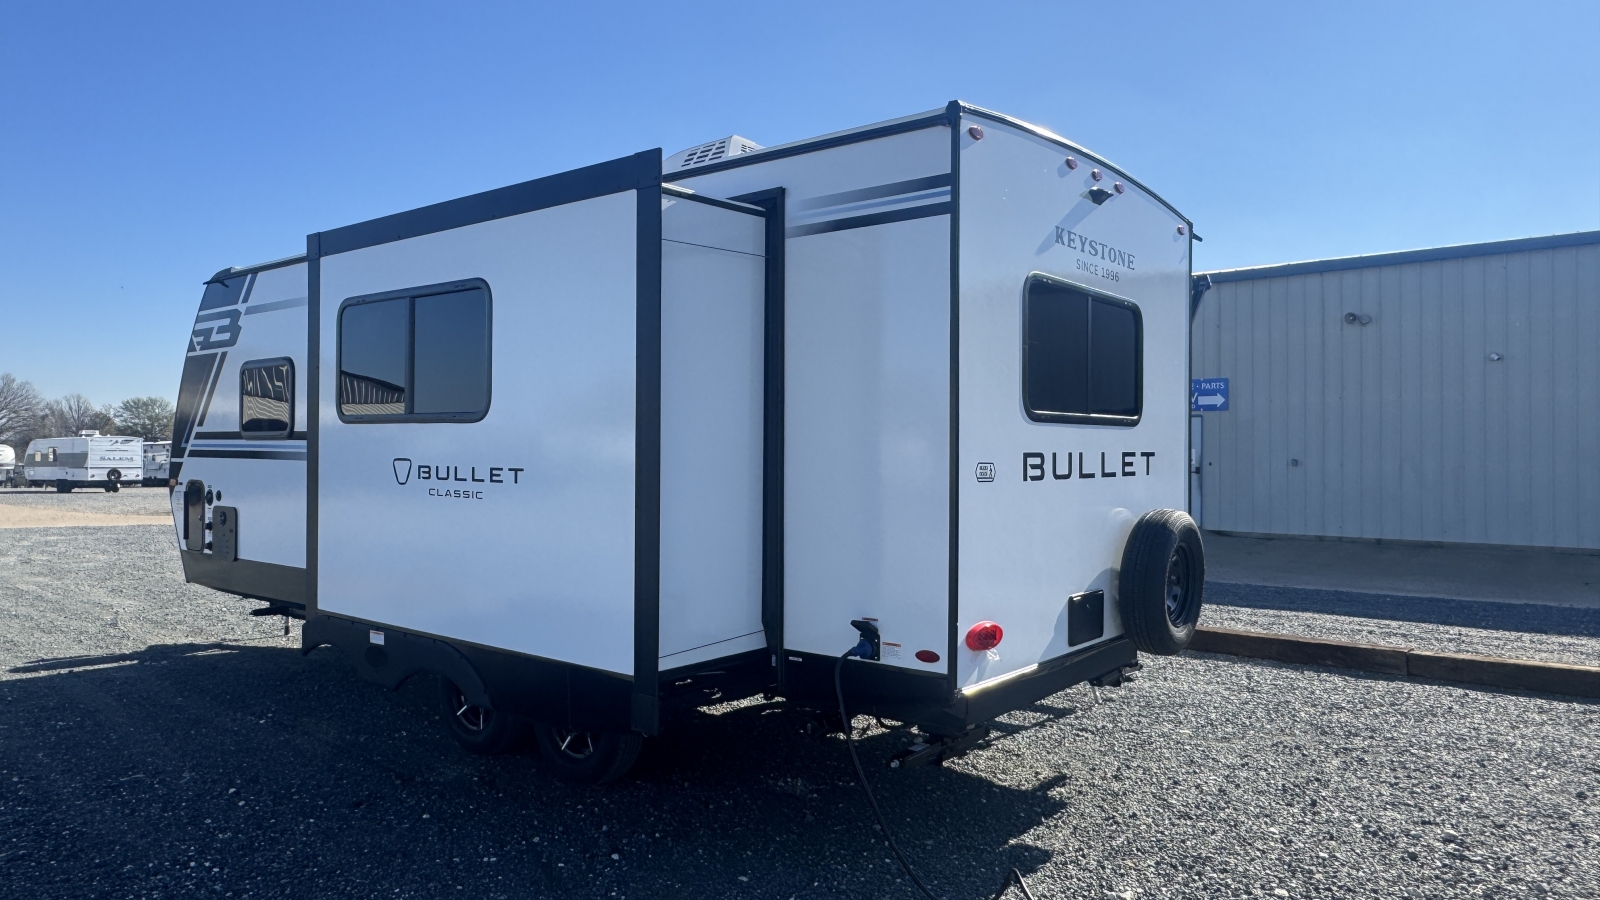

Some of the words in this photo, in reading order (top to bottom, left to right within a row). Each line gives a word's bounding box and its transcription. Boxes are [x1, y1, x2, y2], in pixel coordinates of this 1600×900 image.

[1054, 225, 1136, 271] KEYSTONE
[1076, 258, 1099, 276] SINCE
[1101, 267, 1120, 283] 1996
[1201, 382, 1225, 390] PARTS
[417, 464, 525, 485] BULLET
[1022, 451, 1156, 482] BULLET
[428, 488, 484, 500] CLASSIC
